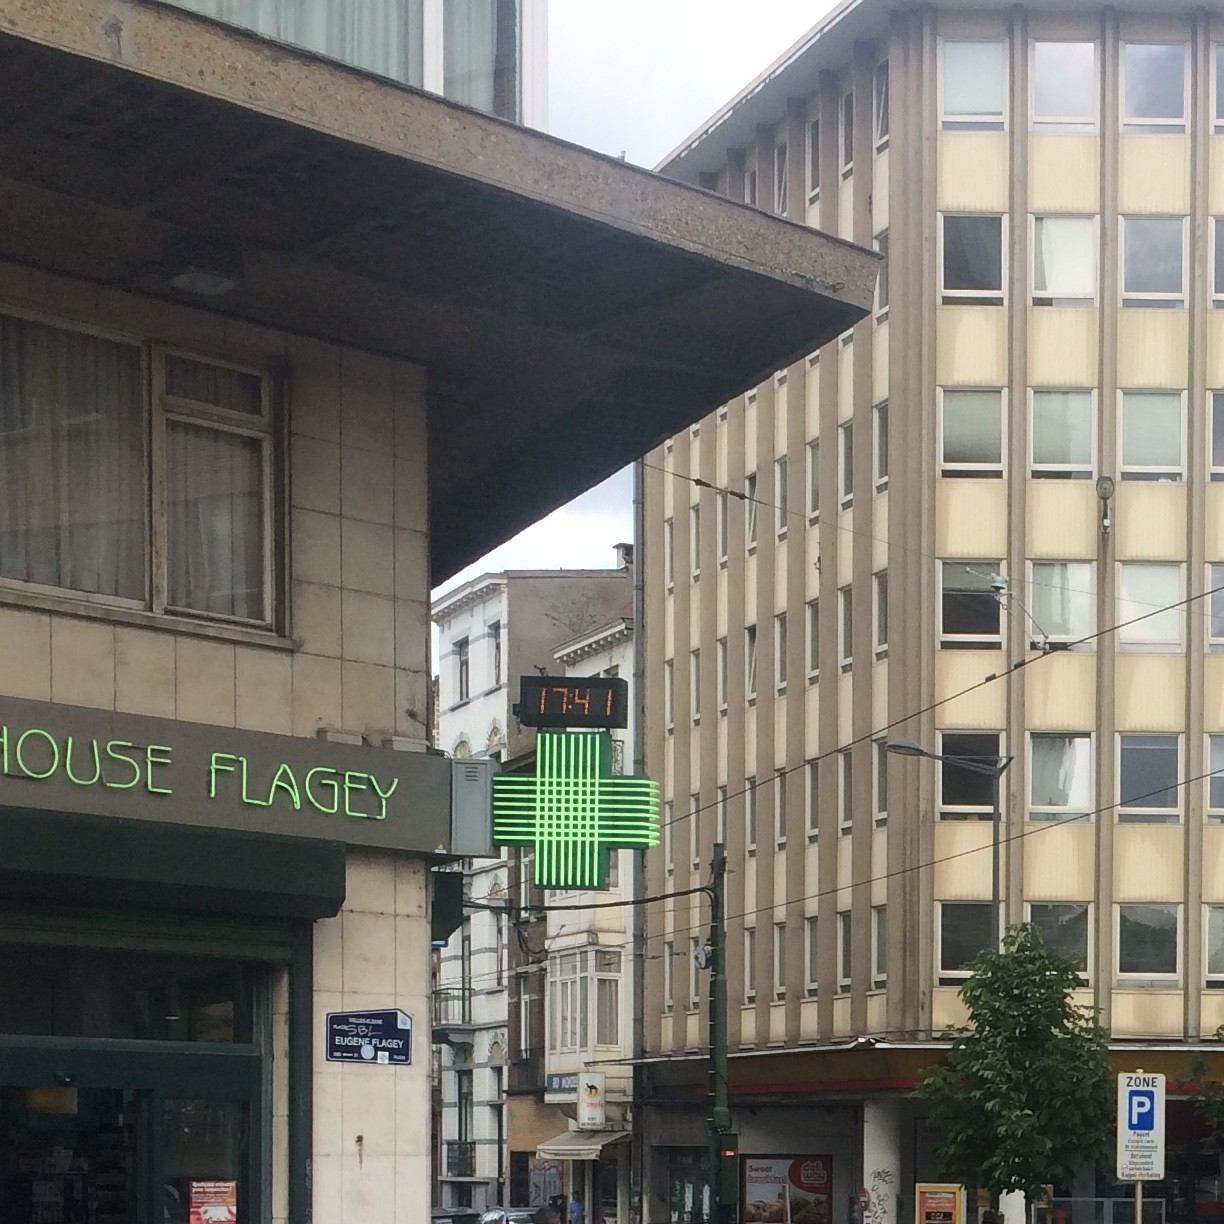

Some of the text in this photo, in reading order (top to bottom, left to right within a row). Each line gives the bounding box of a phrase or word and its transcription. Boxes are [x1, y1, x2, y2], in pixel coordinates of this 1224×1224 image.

[540, 687, 613, 716] 17:41
[209, 752, 399, 820] FLAGEY
[371, 1038, 404, 1049] FLAGEY
[1126, 1076, 1158, 1088] ZONE
[1131, 1095, 1151, 1125] P
